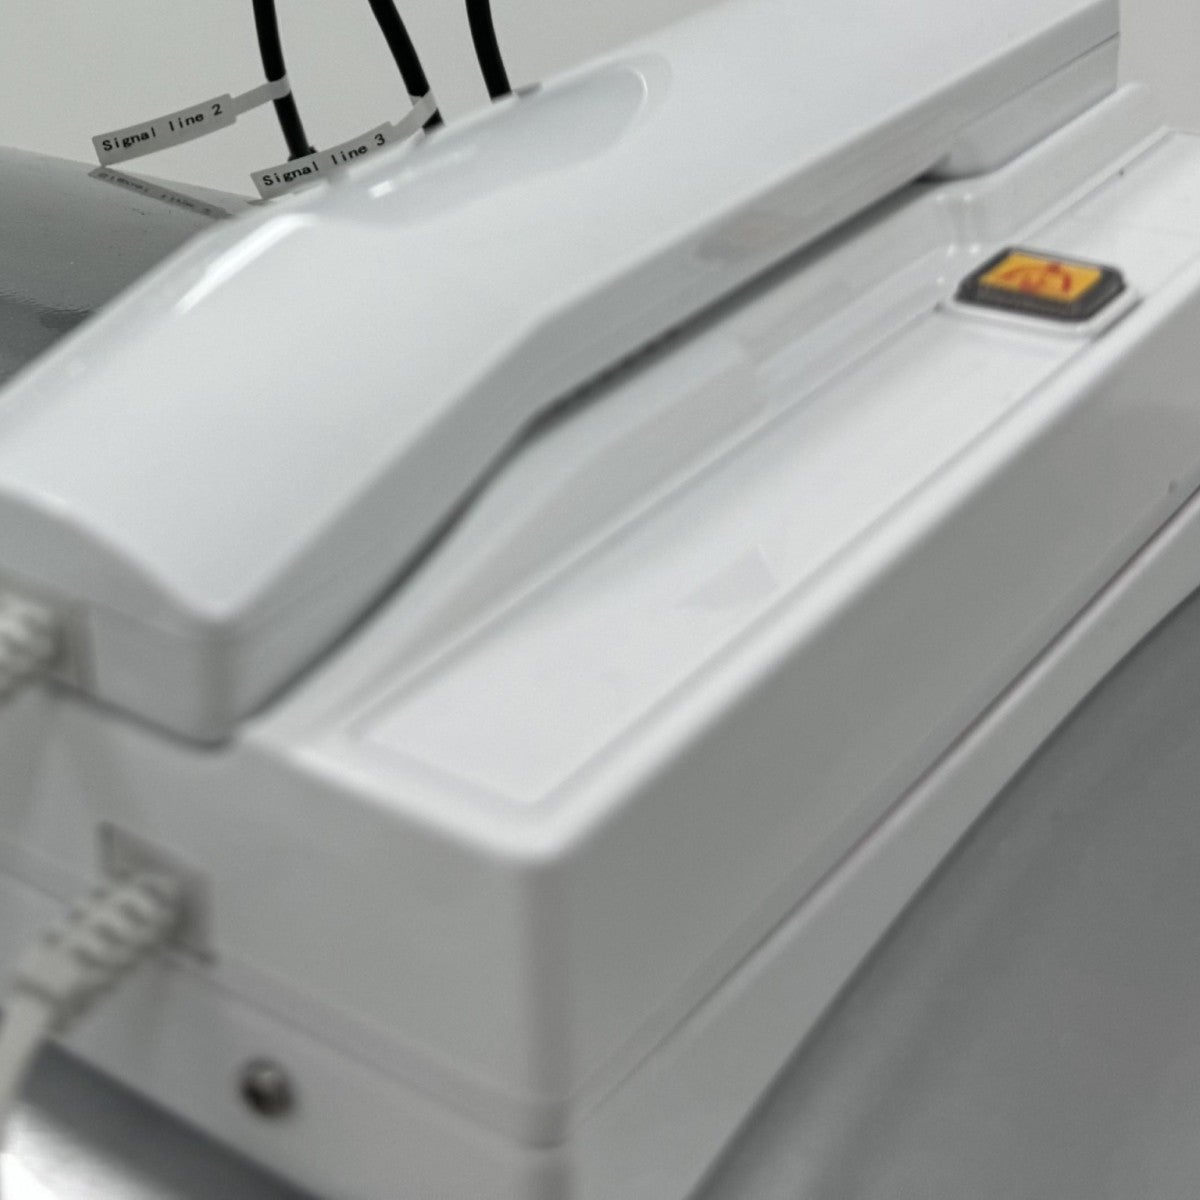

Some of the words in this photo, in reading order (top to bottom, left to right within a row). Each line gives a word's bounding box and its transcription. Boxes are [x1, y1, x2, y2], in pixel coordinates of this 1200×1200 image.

[101, 126, 157, 152] Signal
[169, 114, 204, 131] line
[211, 103, 223, 116] 2
[262, 160, 319, 187] Signal
[331, 146, 367, 165] line
[374, 133, 386, 146] 3
